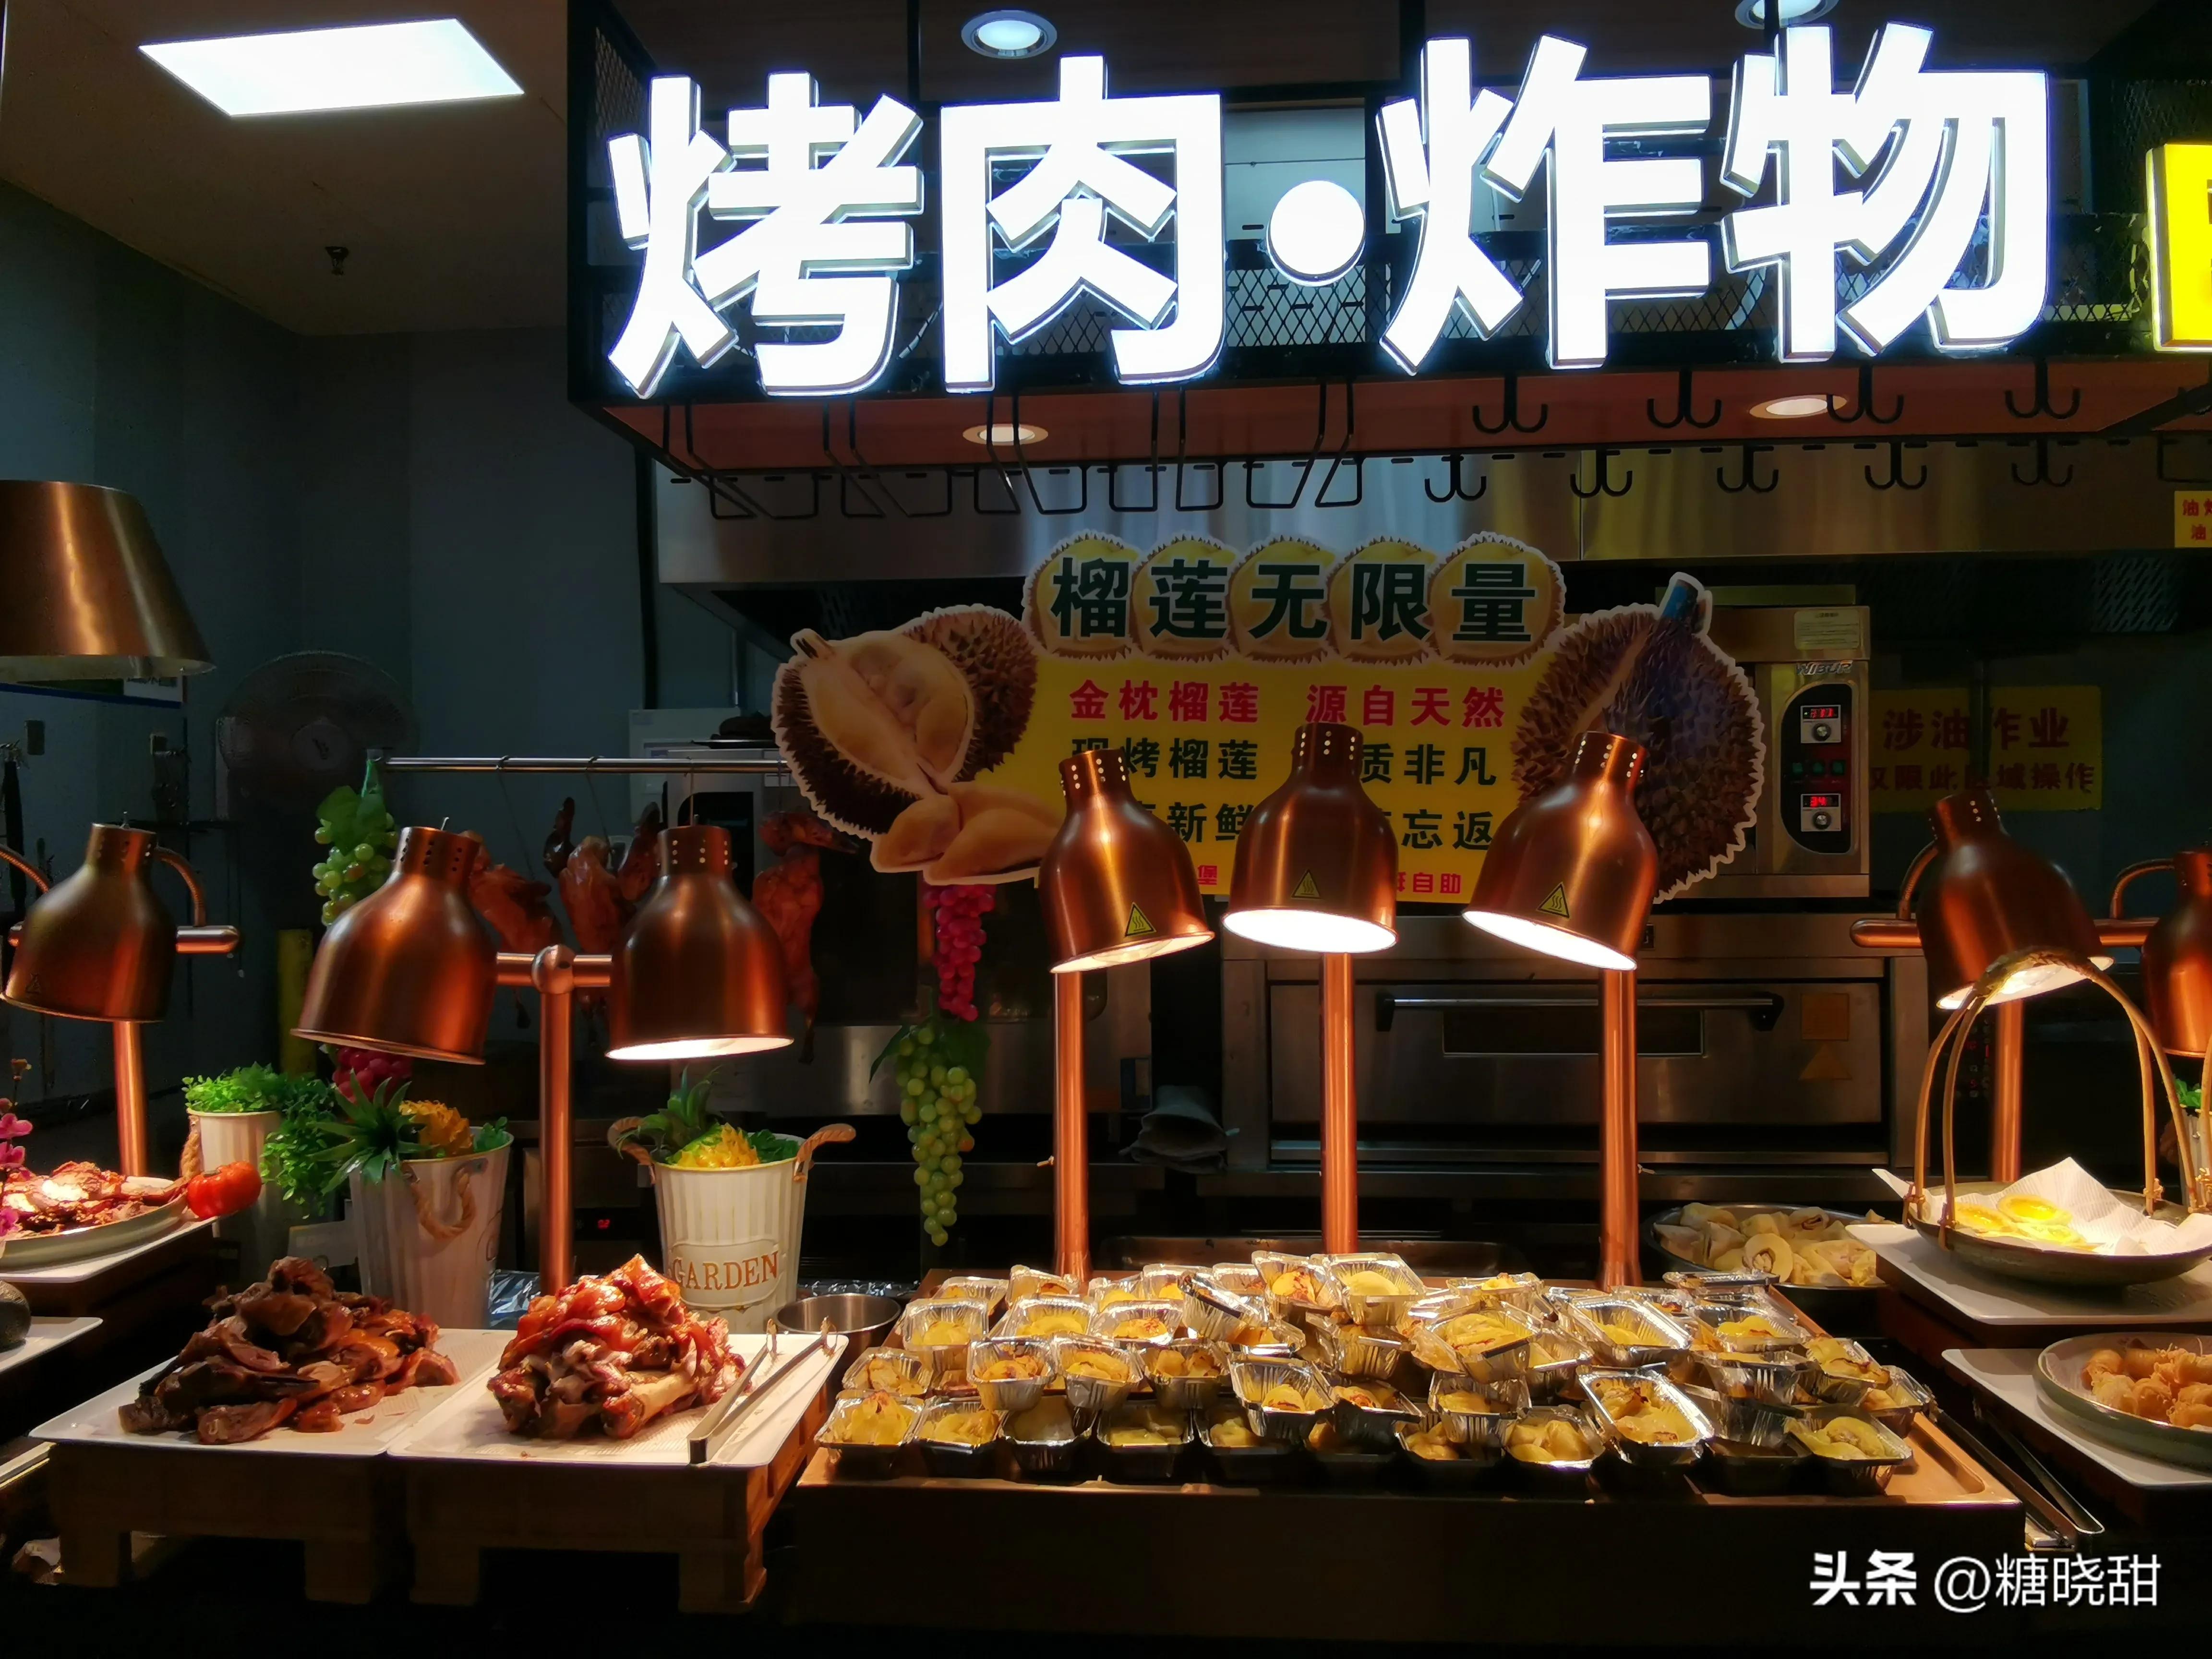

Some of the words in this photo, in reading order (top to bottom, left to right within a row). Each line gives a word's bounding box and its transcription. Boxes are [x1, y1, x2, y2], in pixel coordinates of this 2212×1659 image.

[607, 22, 2050, 397] 烤肉·炸物
[1052, 556, 1535, 644] 榴莲无限量
[1069, 679, 1259, 723] 金枕榴莲
[1306, 684, 1505, 728] 源自天然
[1883, 707, 2070, 750] 涉油作业
[1137, 801, 1256, 843] 新鲜
[1382, 809, 1494, 850] 忘返
[672, 1251, 779, 1291] GARDEN
